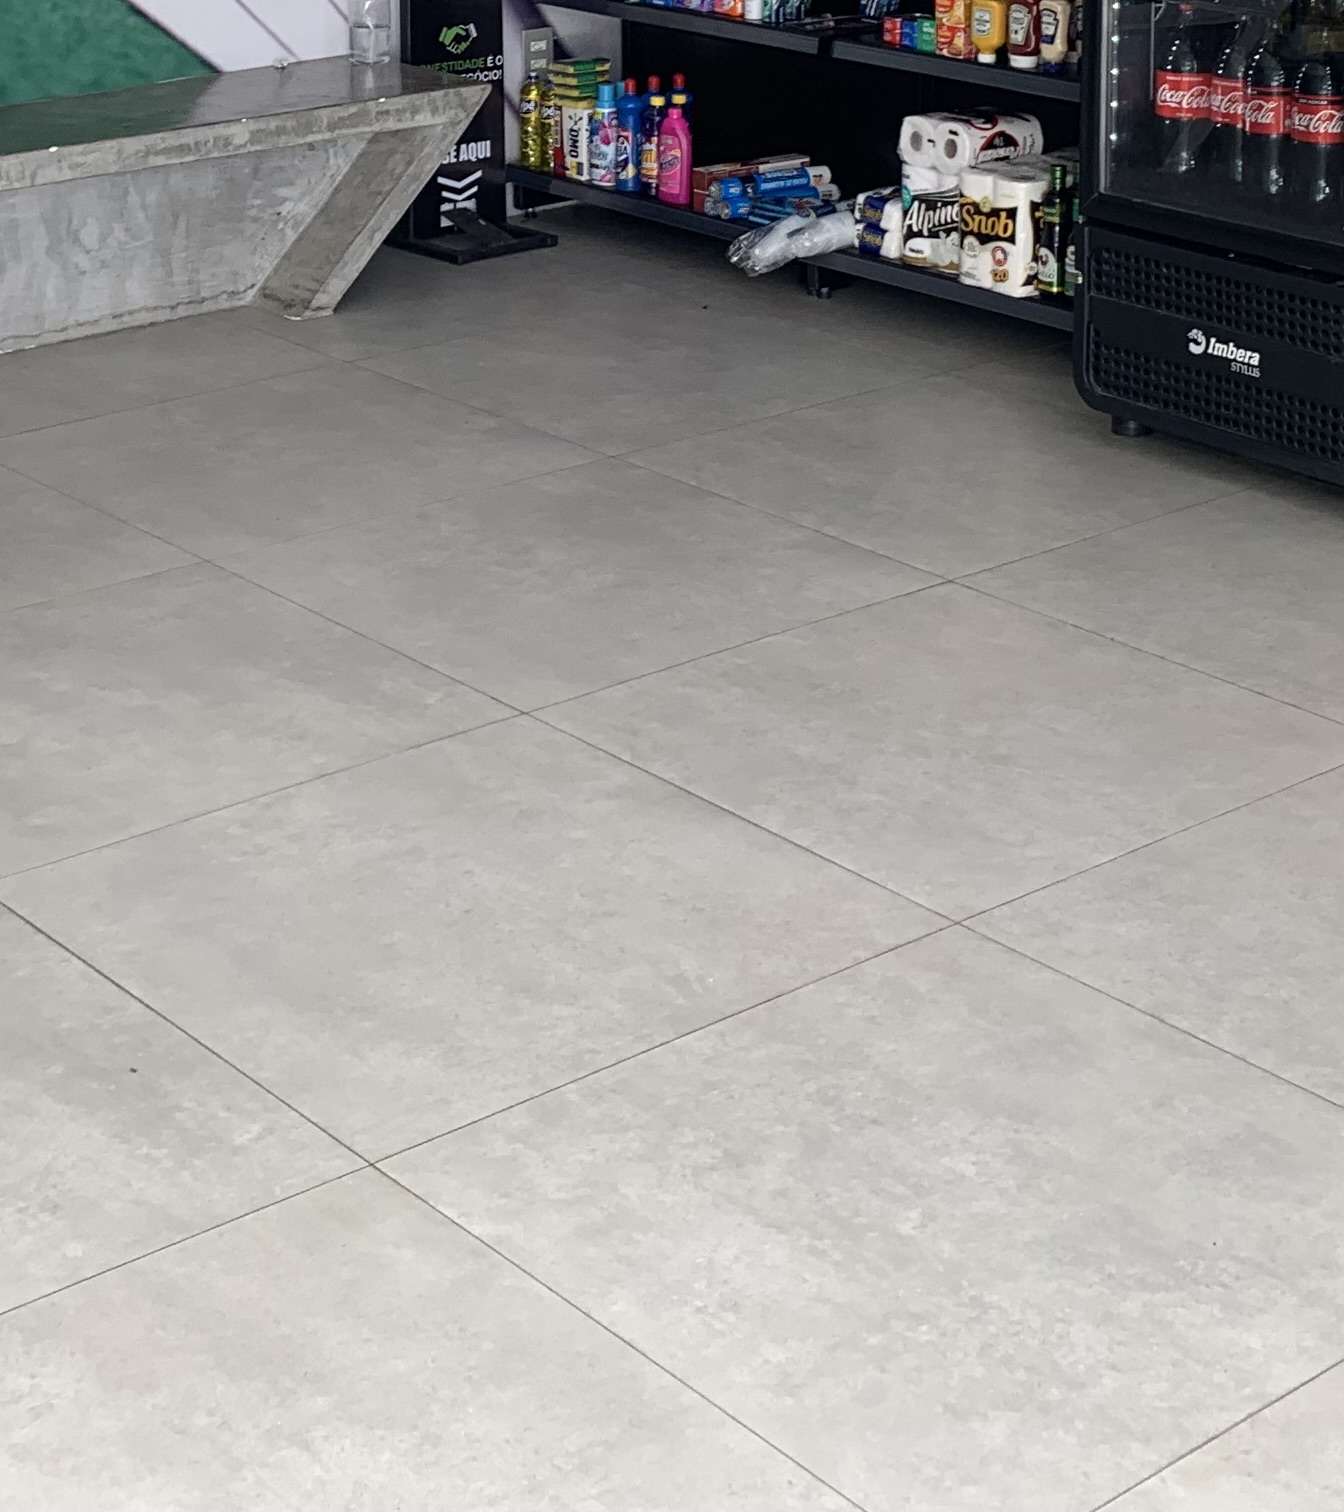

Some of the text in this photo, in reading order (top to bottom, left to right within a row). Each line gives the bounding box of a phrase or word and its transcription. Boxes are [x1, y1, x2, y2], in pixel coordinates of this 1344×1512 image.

[487, 54, 494, 67] É
[495, 55, 503, 66] O
[459, 140, 491, 162] AQUI
[569, 129, 580, 159] OMO
[961, 204, 1014, 238] Snob
[1207, 337, 1260, 367] Imbera
